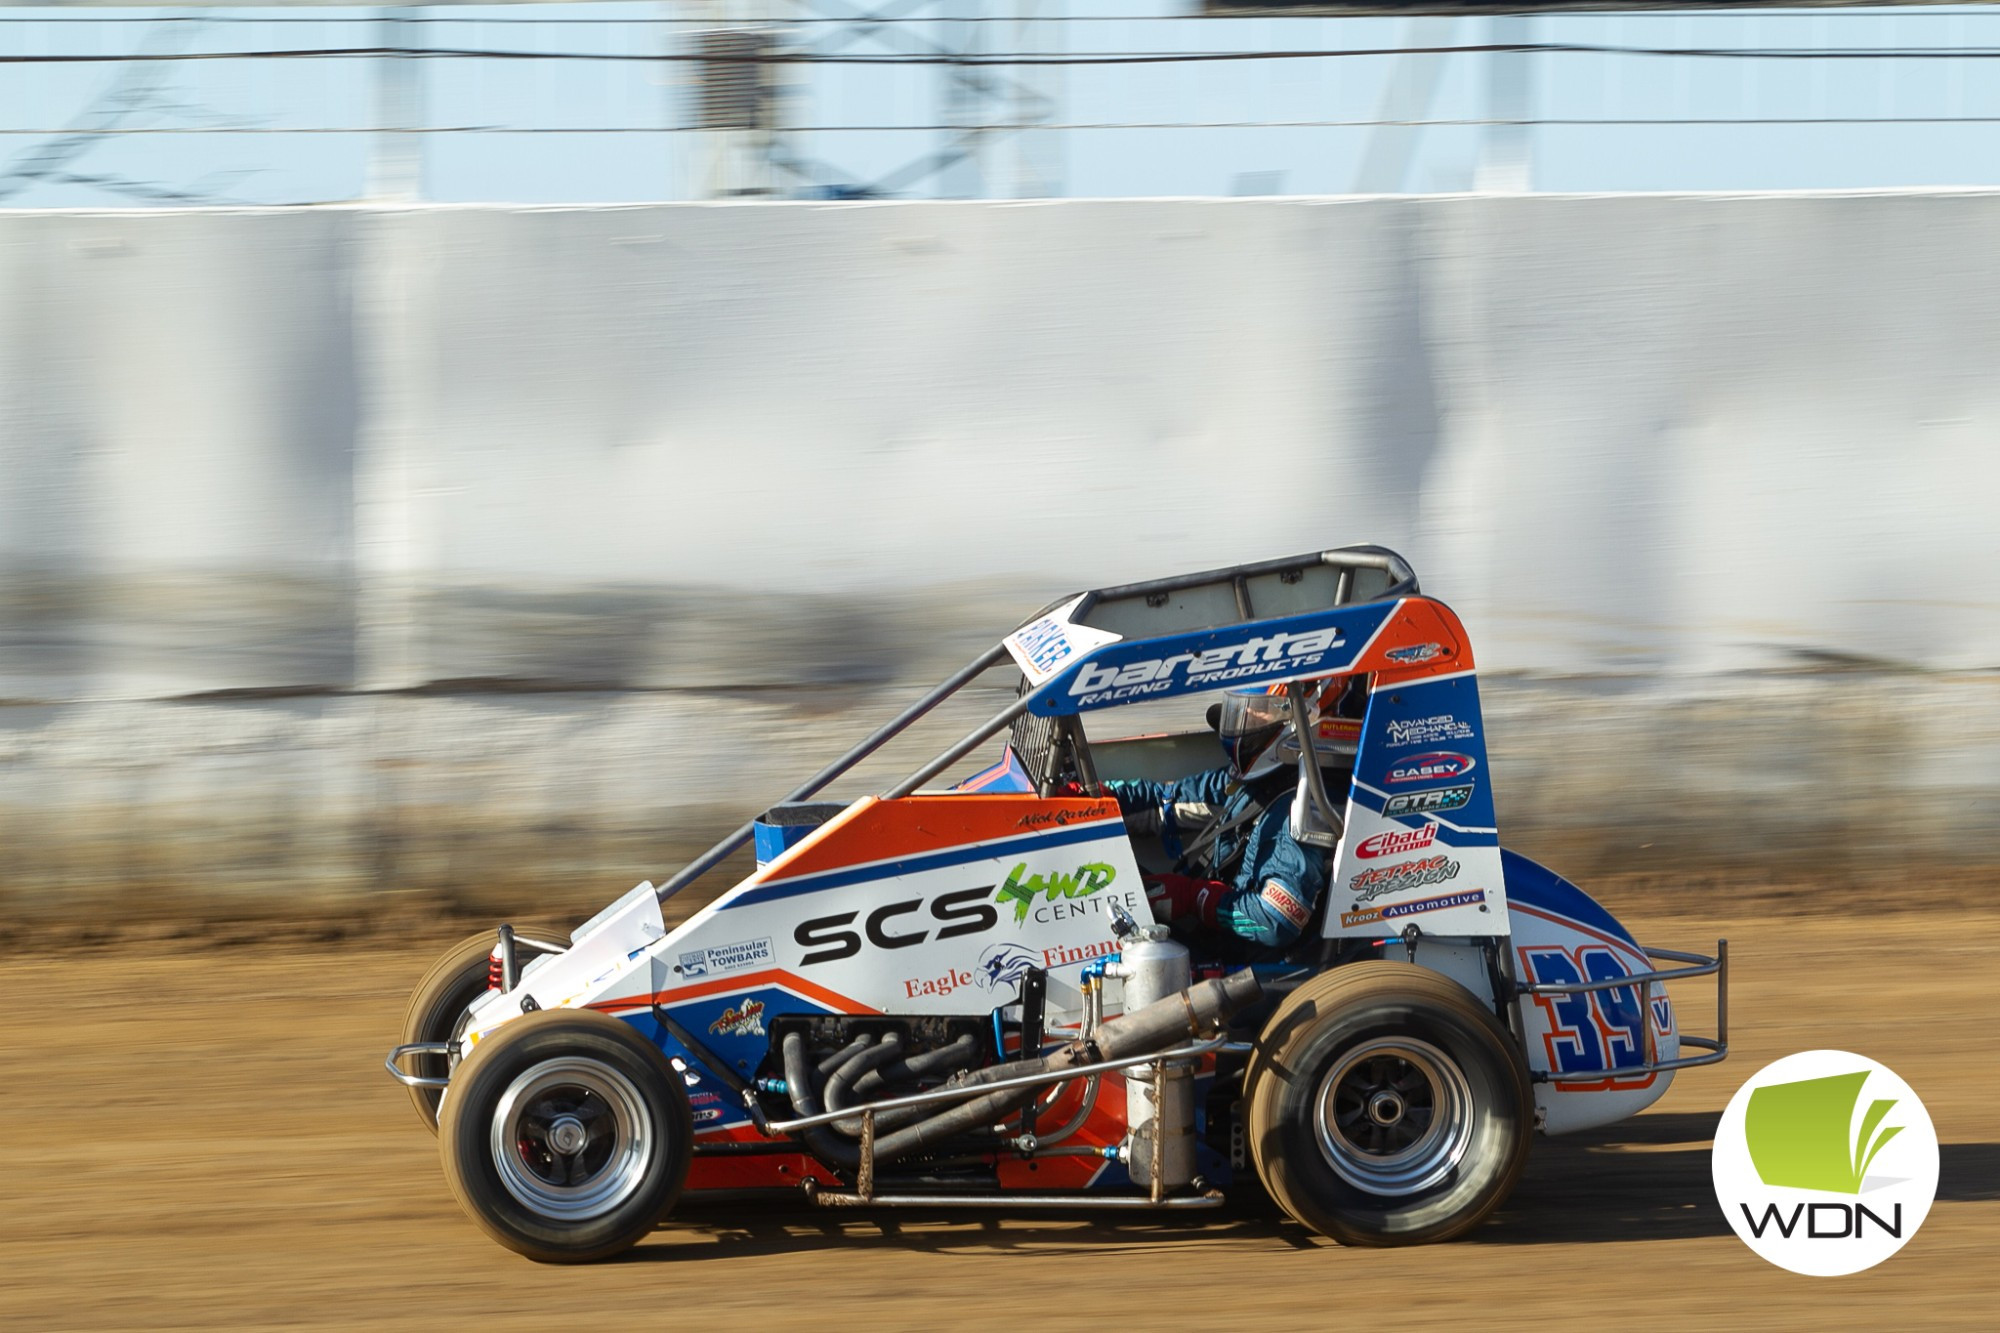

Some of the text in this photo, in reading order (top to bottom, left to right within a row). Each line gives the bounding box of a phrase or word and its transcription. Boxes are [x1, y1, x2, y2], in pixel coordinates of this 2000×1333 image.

[1078, 652, 1324, 707] RACING PRODUCTS
[1393, 764, 1458, 778] CASEY
[1355, 823, 1436, 859] Eibach
[794, 862, 1117, 967] SCS 4WD
[1035, 891, 1137, 923] CENTRE
[1265, 886, 1307, 922] SIMPSON
[1345, 893, 1480, 925] Krooz Automotive
[707, 941, 767, 958] Peninsular
[710, 949, 769, 967] TOWBARS
[903, 969, 974, 1000] Eagle
[1517, 946, 1657, 1092] 39
